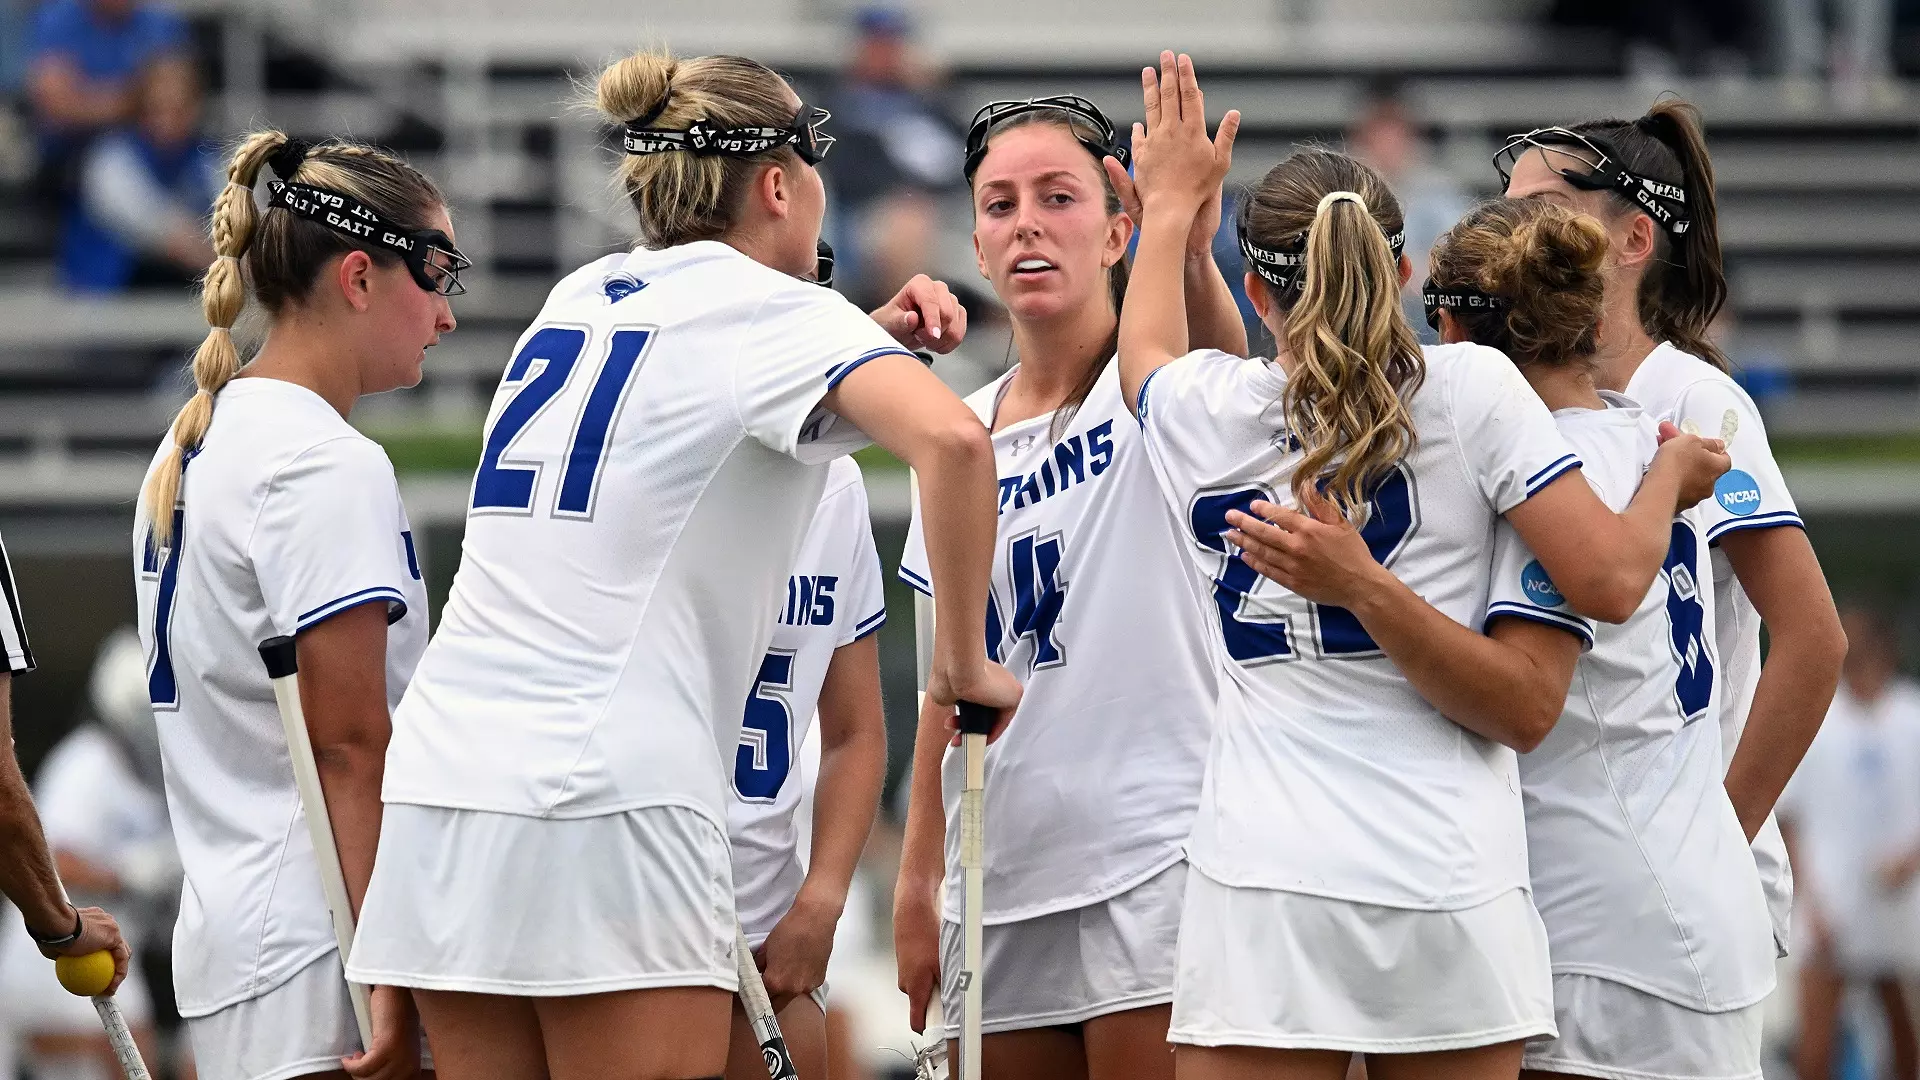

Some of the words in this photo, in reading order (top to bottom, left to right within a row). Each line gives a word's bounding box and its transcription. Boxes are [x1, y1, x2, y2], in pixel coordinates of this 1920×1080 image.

[1636, 189, 1671, 222] GAIT
[326, 211, 374, 237] GAIT
[382, 231, 415, 251] GAI
[1257, 264, 1287, 287] GAIT
[1439, 294, 1462, 307] GAIT
[469, 321, 660, 523] 21
[1722, 489, 1760, 506] NCAA
[778, 575, 839, 626] INS
[730, 647, 798, 806] 5
